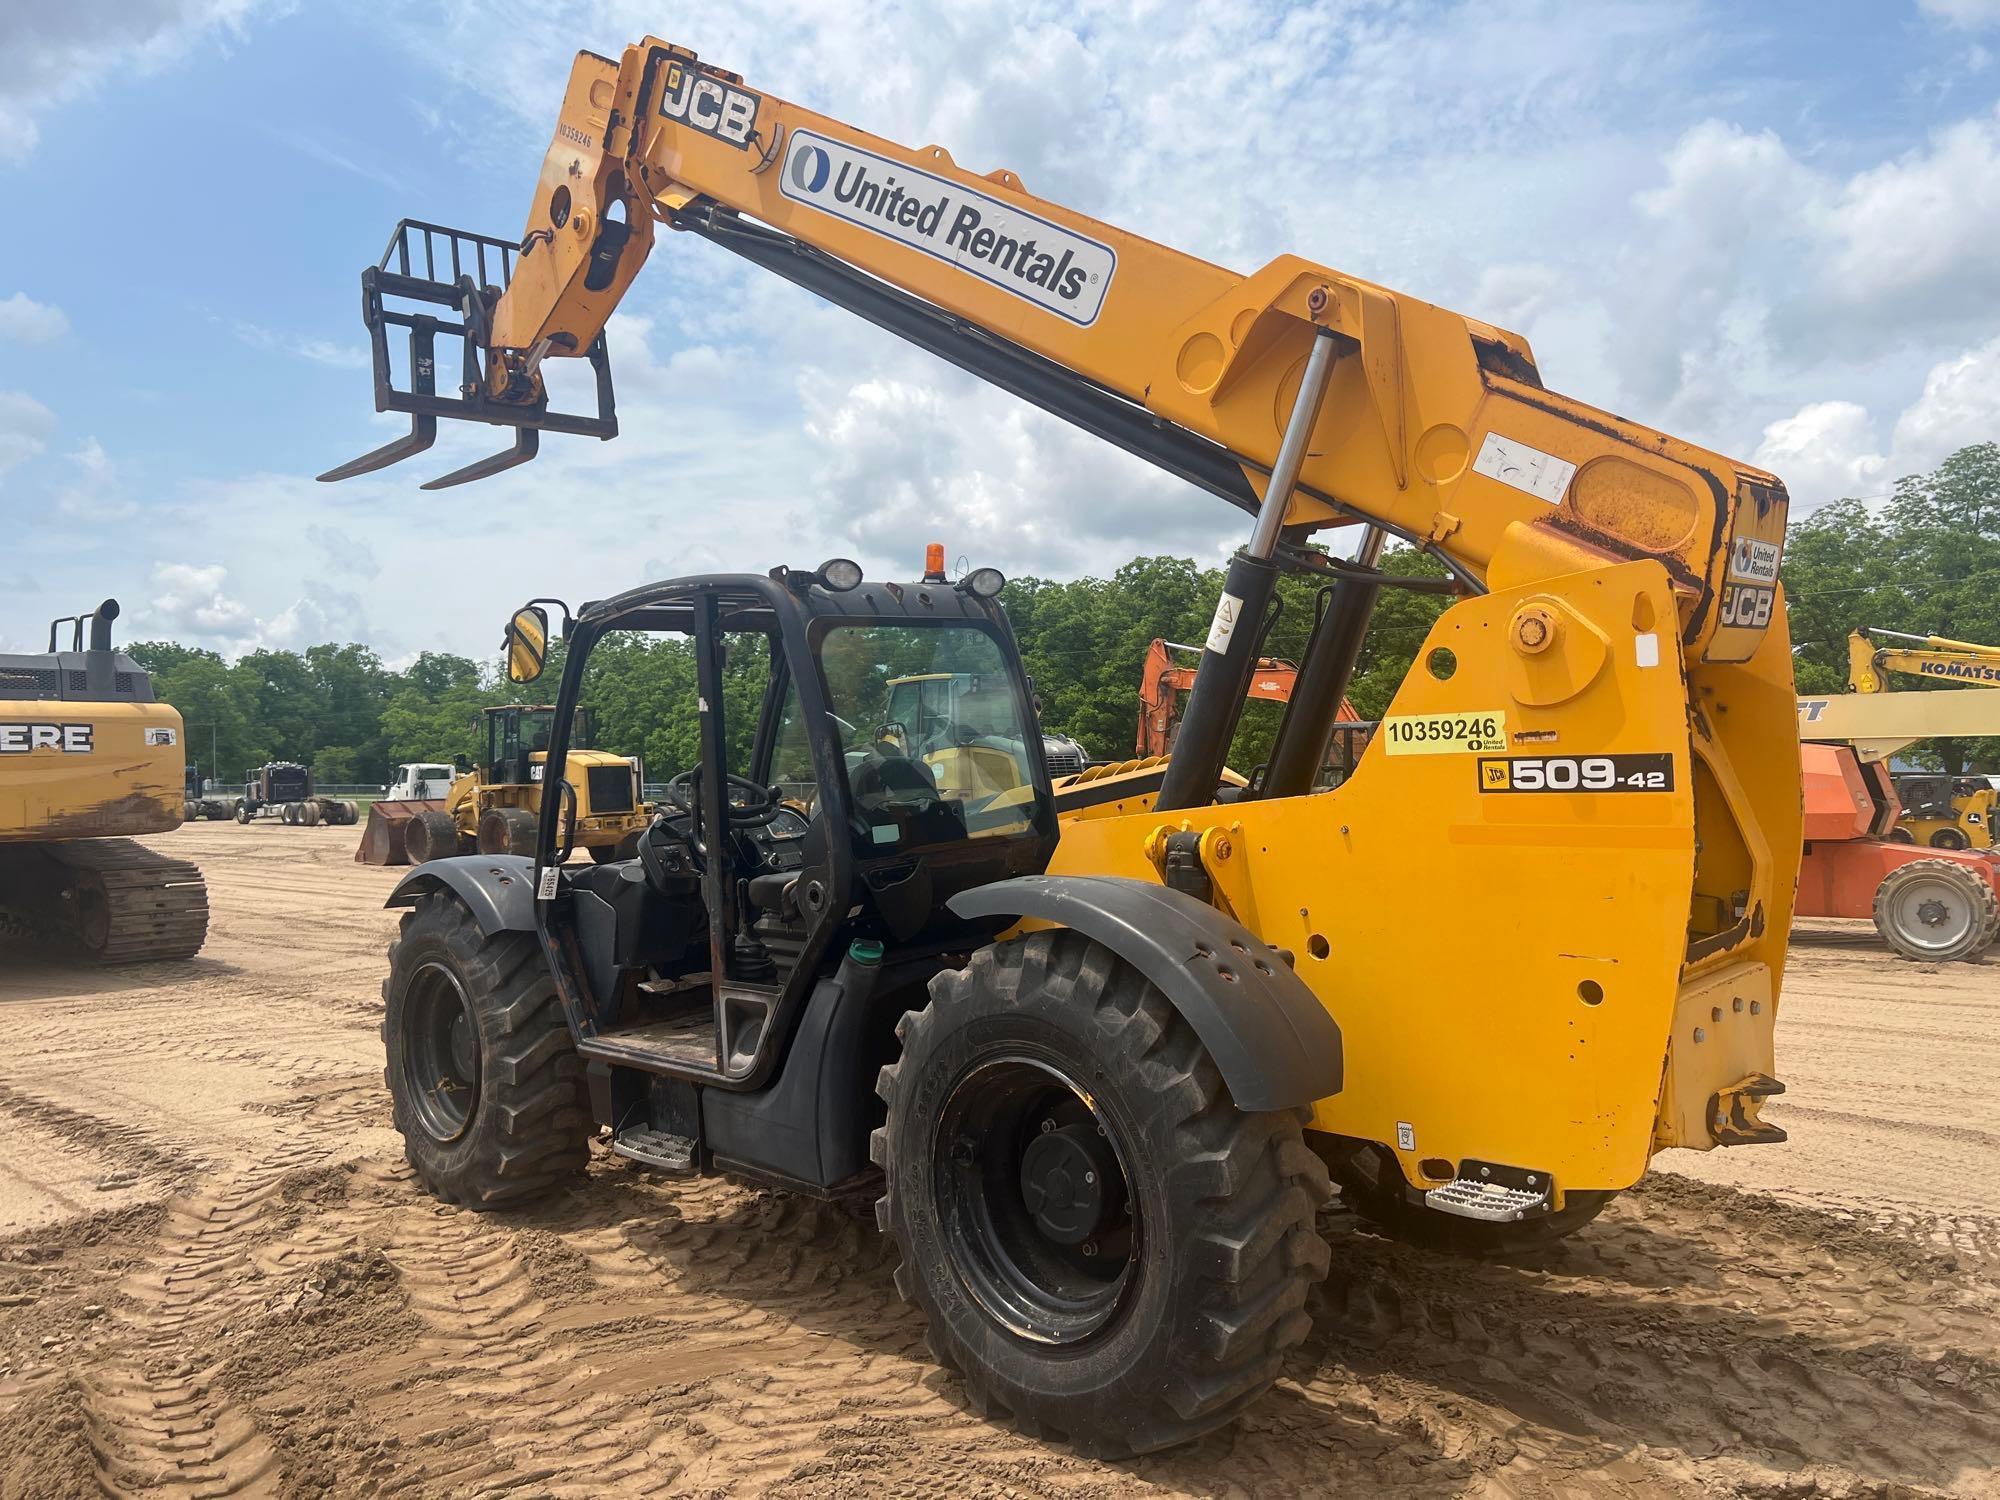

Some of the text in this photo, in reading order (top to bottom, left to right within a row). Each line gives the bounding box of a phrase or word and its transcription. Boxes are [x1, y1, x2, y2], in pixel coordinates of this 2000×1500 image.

[663, 74, 756, 143] JCB
[559, 123, 592, 148] 10359246
[834, 160, 1088, 300] United Rentals
[1753, 547, 1776, 562] United
[1750, 561, 1774, 577] Rentals
[1721, 587, 1773, 625] JCB
[1388, 718, 1497, 742] 10359246
[530, 765, 544, 781] CAT
[1488, 758, 1666, 790] JCB 509-42
